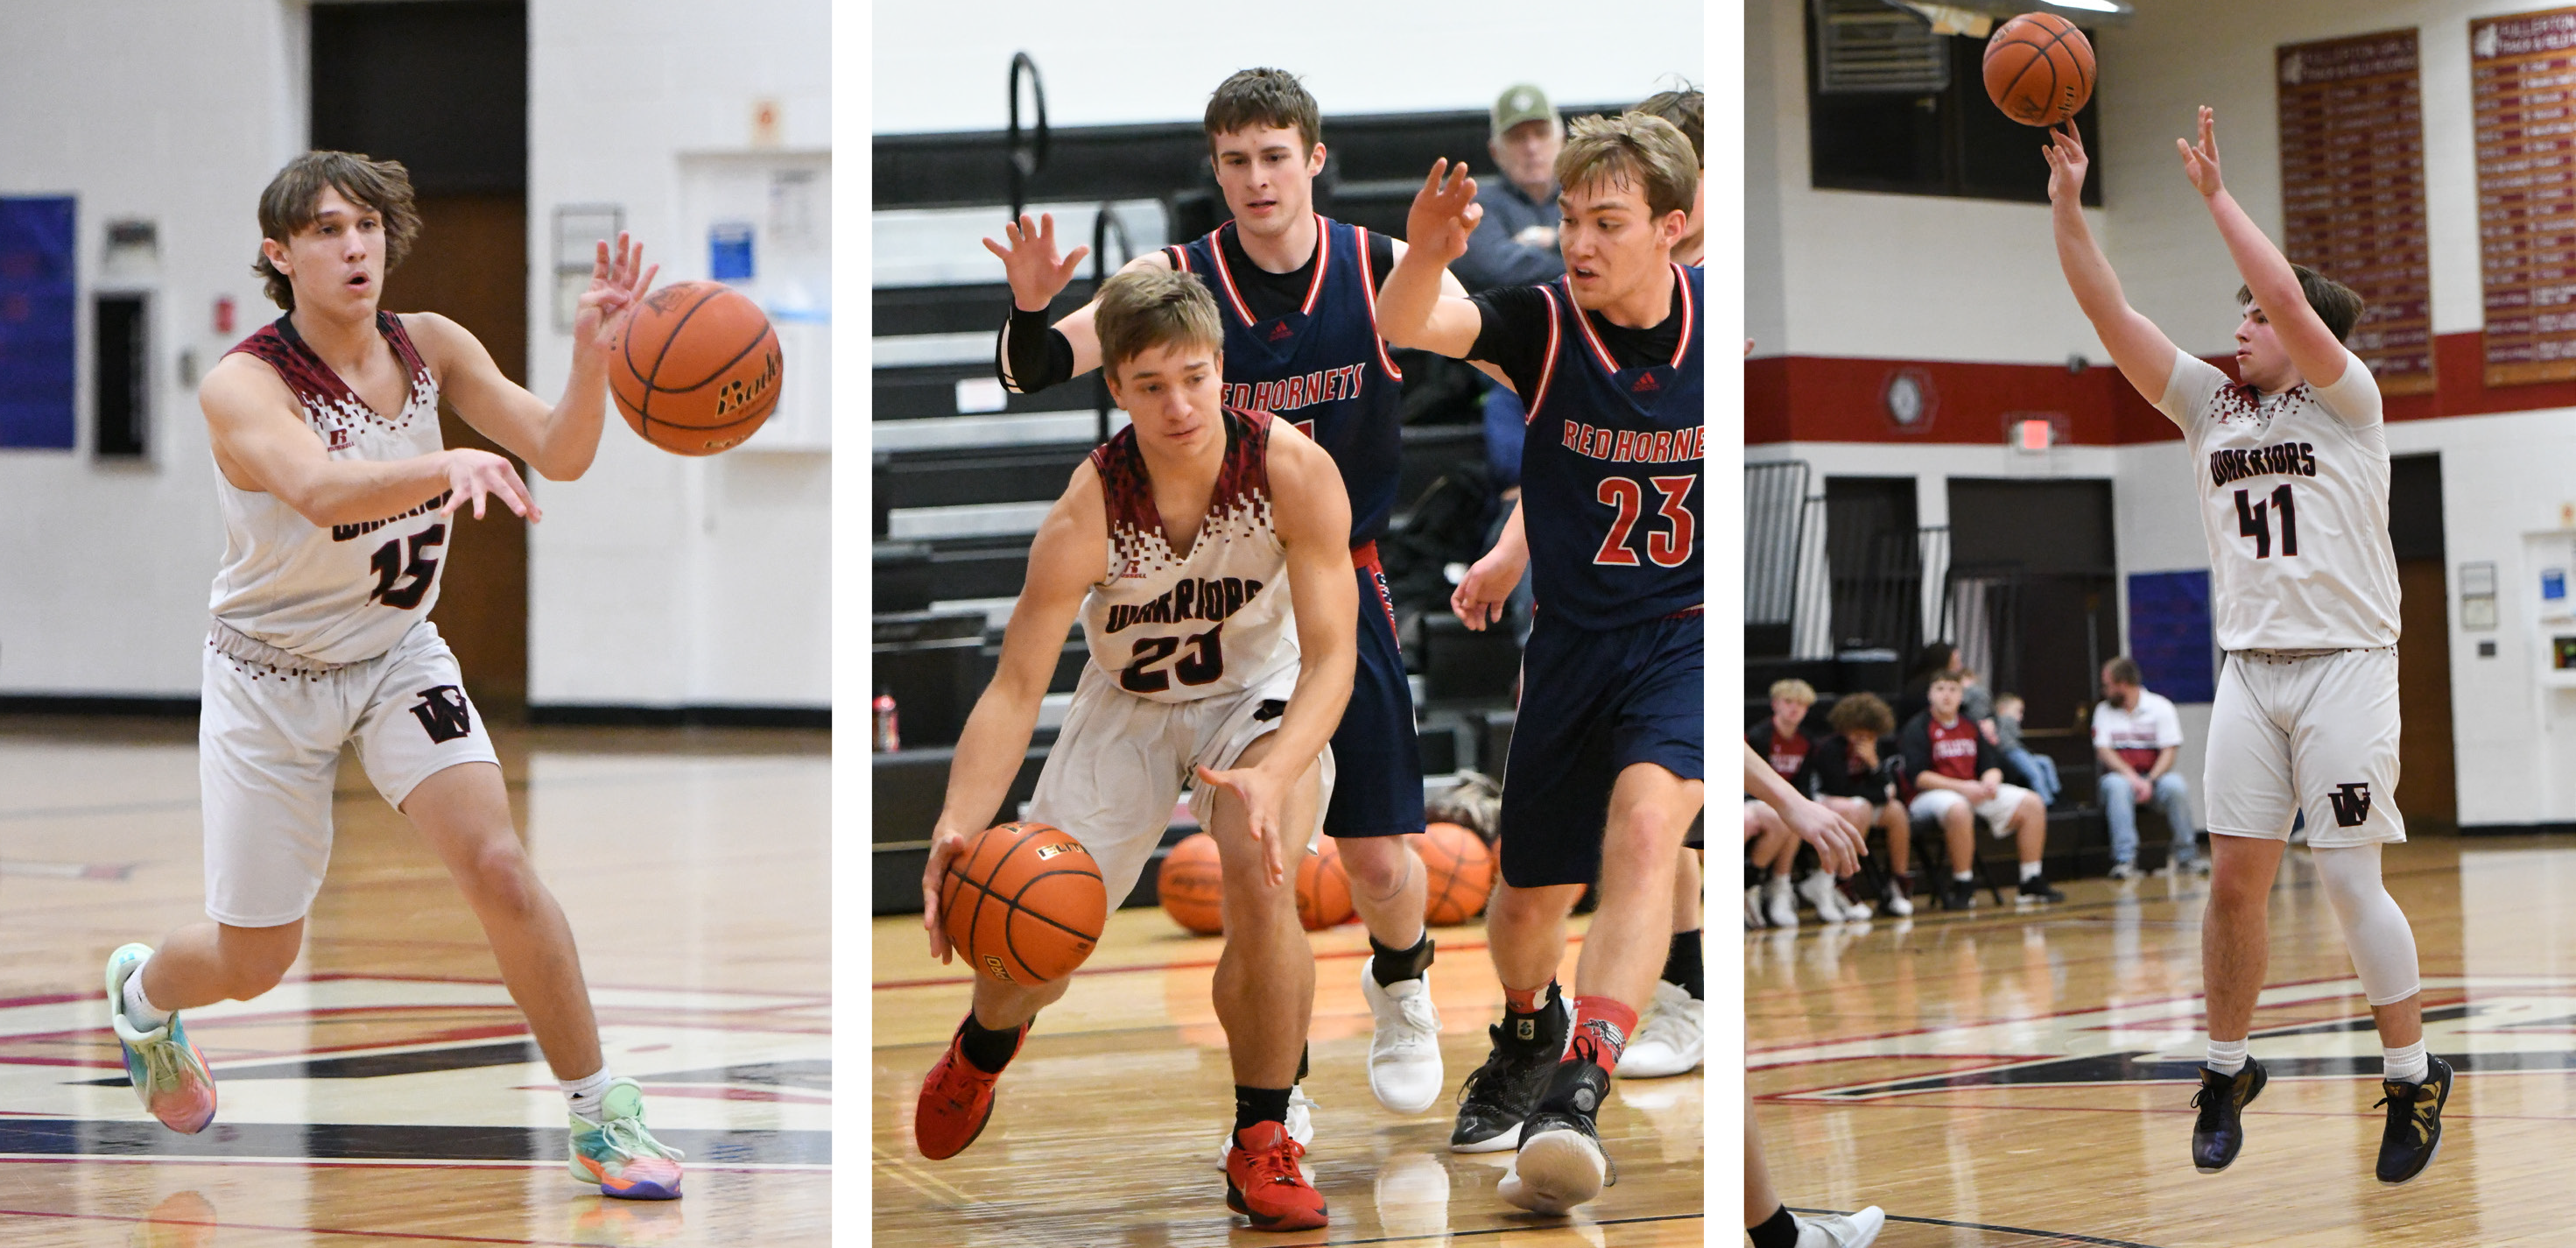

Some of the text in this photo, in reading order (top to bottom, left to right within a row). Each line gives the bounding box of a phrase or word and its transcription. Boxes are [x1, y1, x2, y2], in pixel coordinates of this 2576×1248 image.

[1221, 363, 1366, 412] ED HORNETS
[1562, 419, 1704, 463] RED HORNE
[2210, 442, 2316, 487] WARRIORS
[1593, 474, 1697, 568] 23
[2235, 483, 2298, 560] 41
[369, 524, 446, 610] 15
